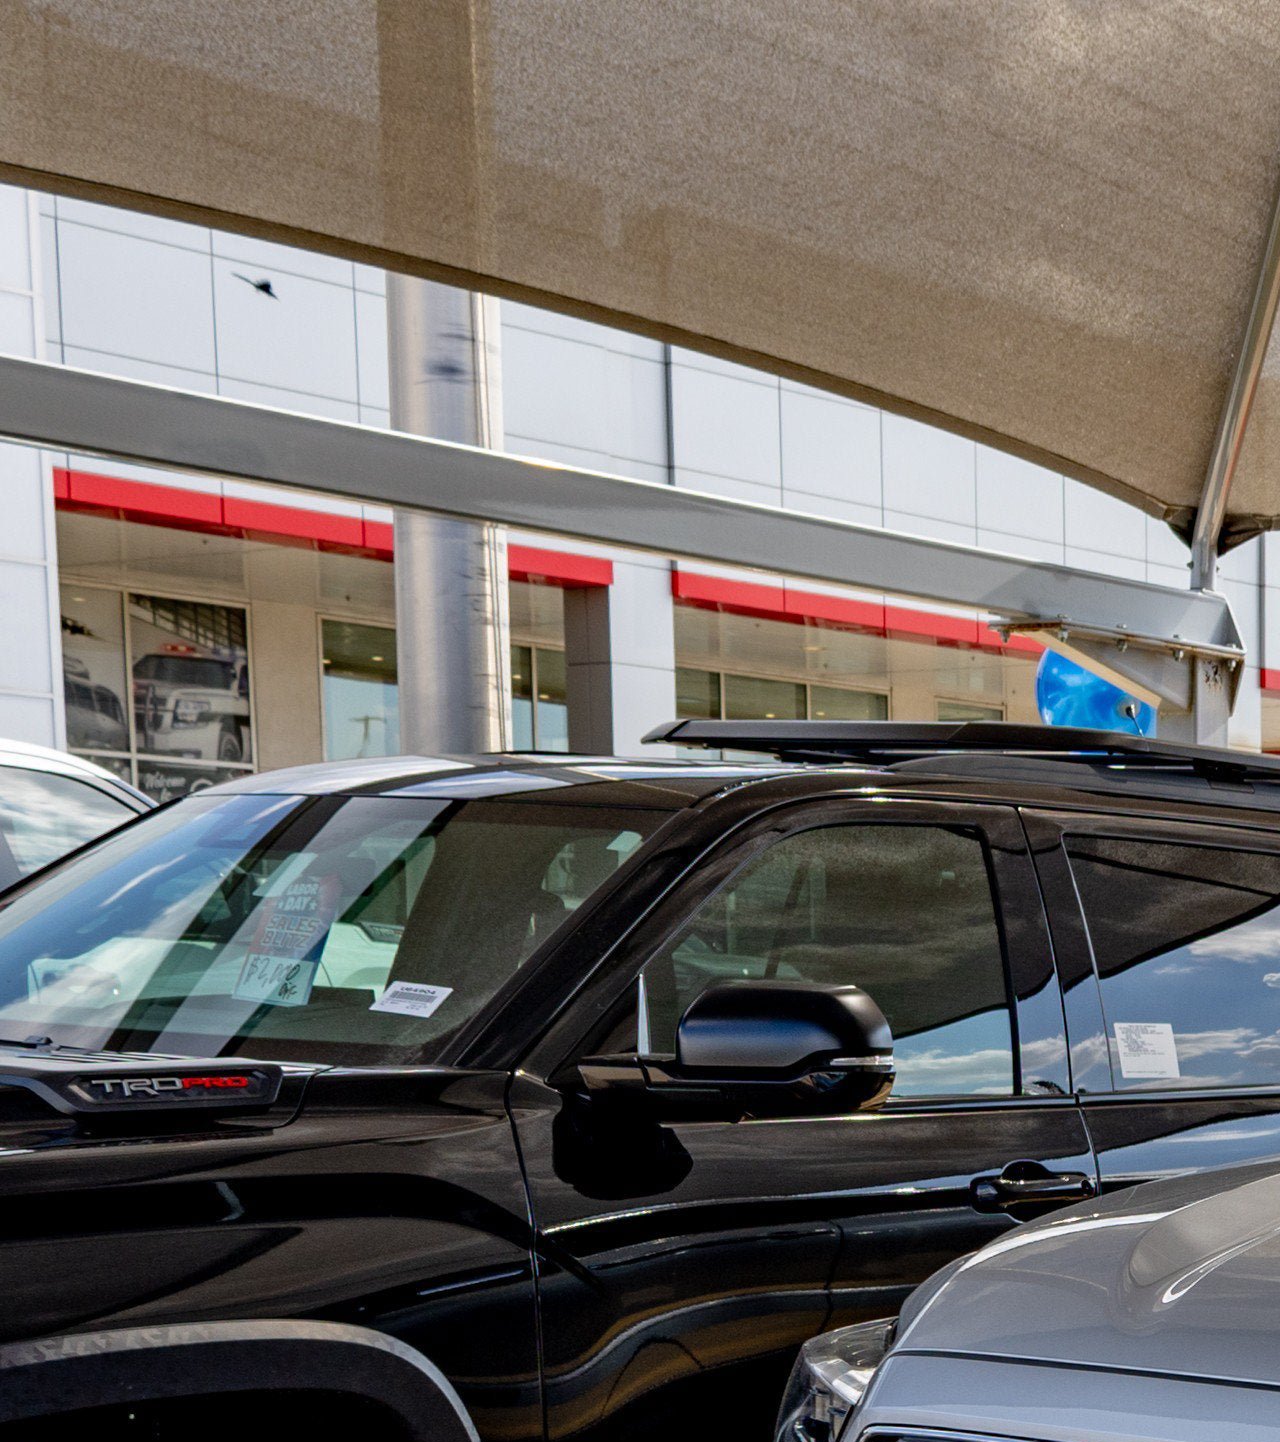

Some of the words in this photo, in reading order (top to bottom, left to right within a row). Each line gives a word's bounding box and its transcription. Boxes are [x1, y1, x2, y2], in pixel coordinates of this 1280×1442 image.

[288, 883, 319, 896] LABOR
[285, 897, 312, 911] DAY
[270, 915, 322, 934] SALES
[261, 929, 311, 949] BLITZ
